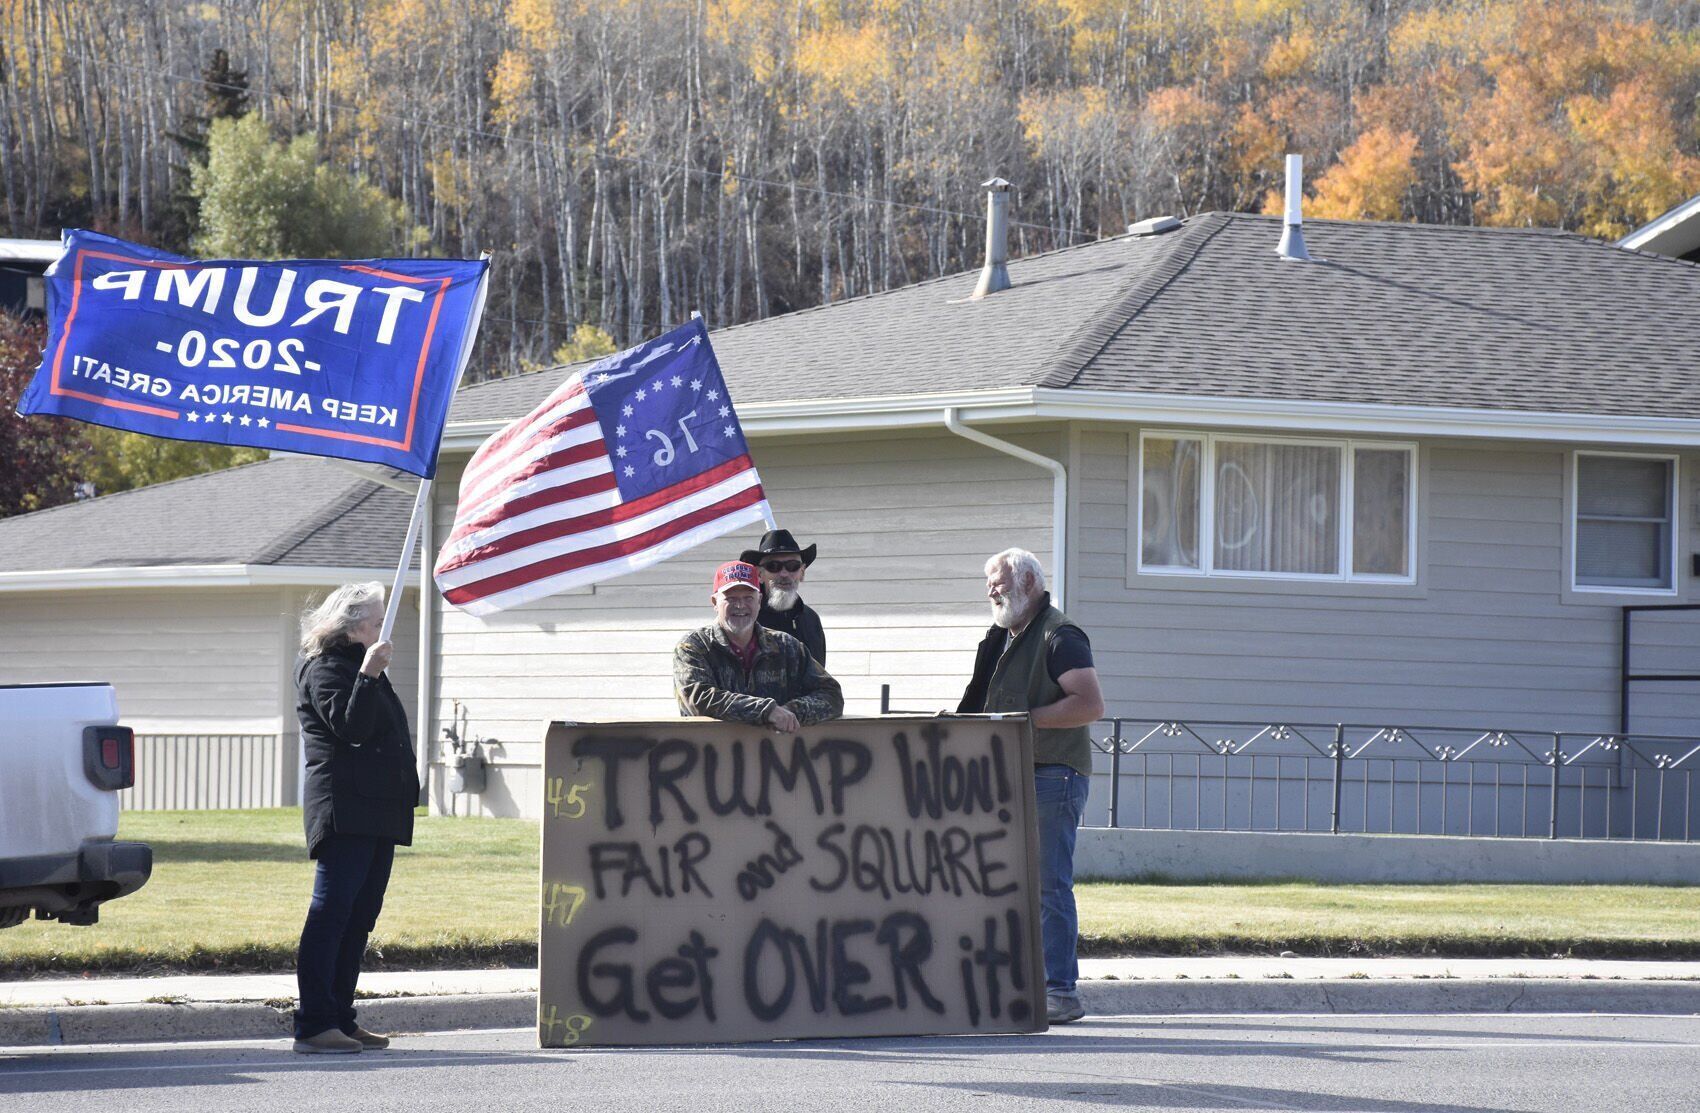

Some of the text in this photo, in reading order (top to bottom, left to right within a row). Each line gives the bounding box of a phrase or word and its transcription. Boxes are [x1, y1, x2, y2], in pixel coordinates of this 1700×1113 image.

[547, 777, 591, 819] 45
[571, 735, 873, 830] TRUMP
[588, 820, 1018, 901] FAIR and SQUARE
[543, 881, 587, 926] 47
[576, 908, 1032, 1028] Get OVER it!
[540, 1003, 592, 1045] 48
